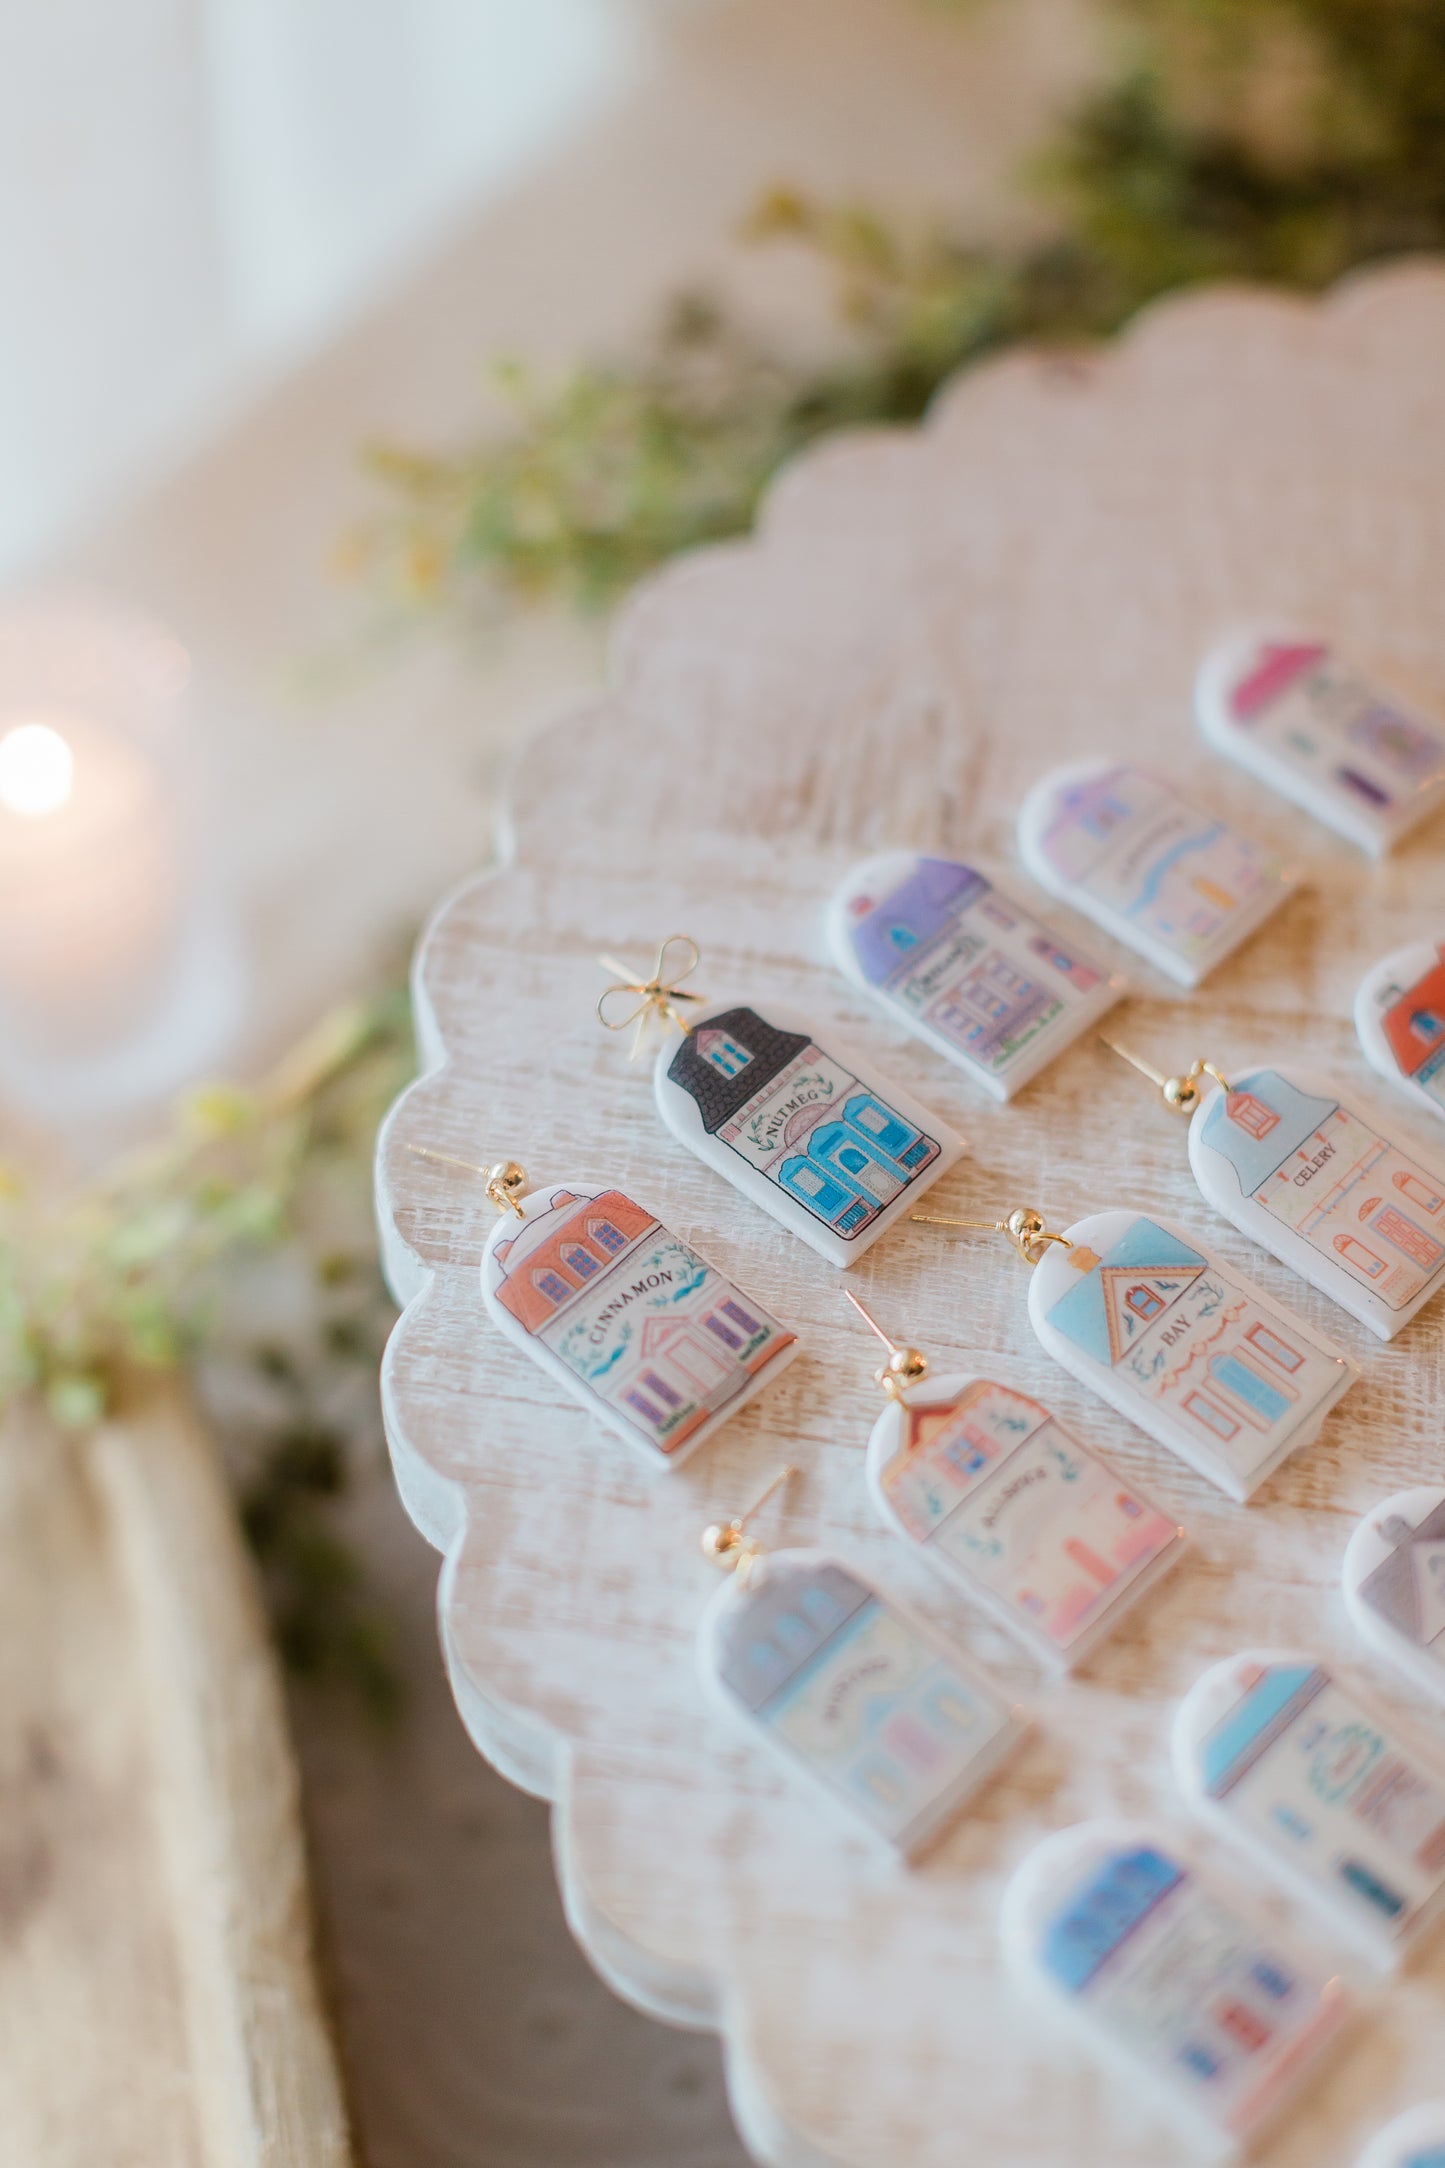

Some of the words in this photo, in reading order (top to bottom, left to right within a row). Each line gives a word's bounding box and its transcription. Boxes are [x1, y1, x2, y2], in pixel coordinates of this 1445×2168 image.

[766, 1089, 818, 1138] NUTMEG
[1293, 1142, 1337, 1187] CELERY
[589, 1270, 673, 1345] CINNAMON
[1161, 1314, 1192, 1347] BAY
